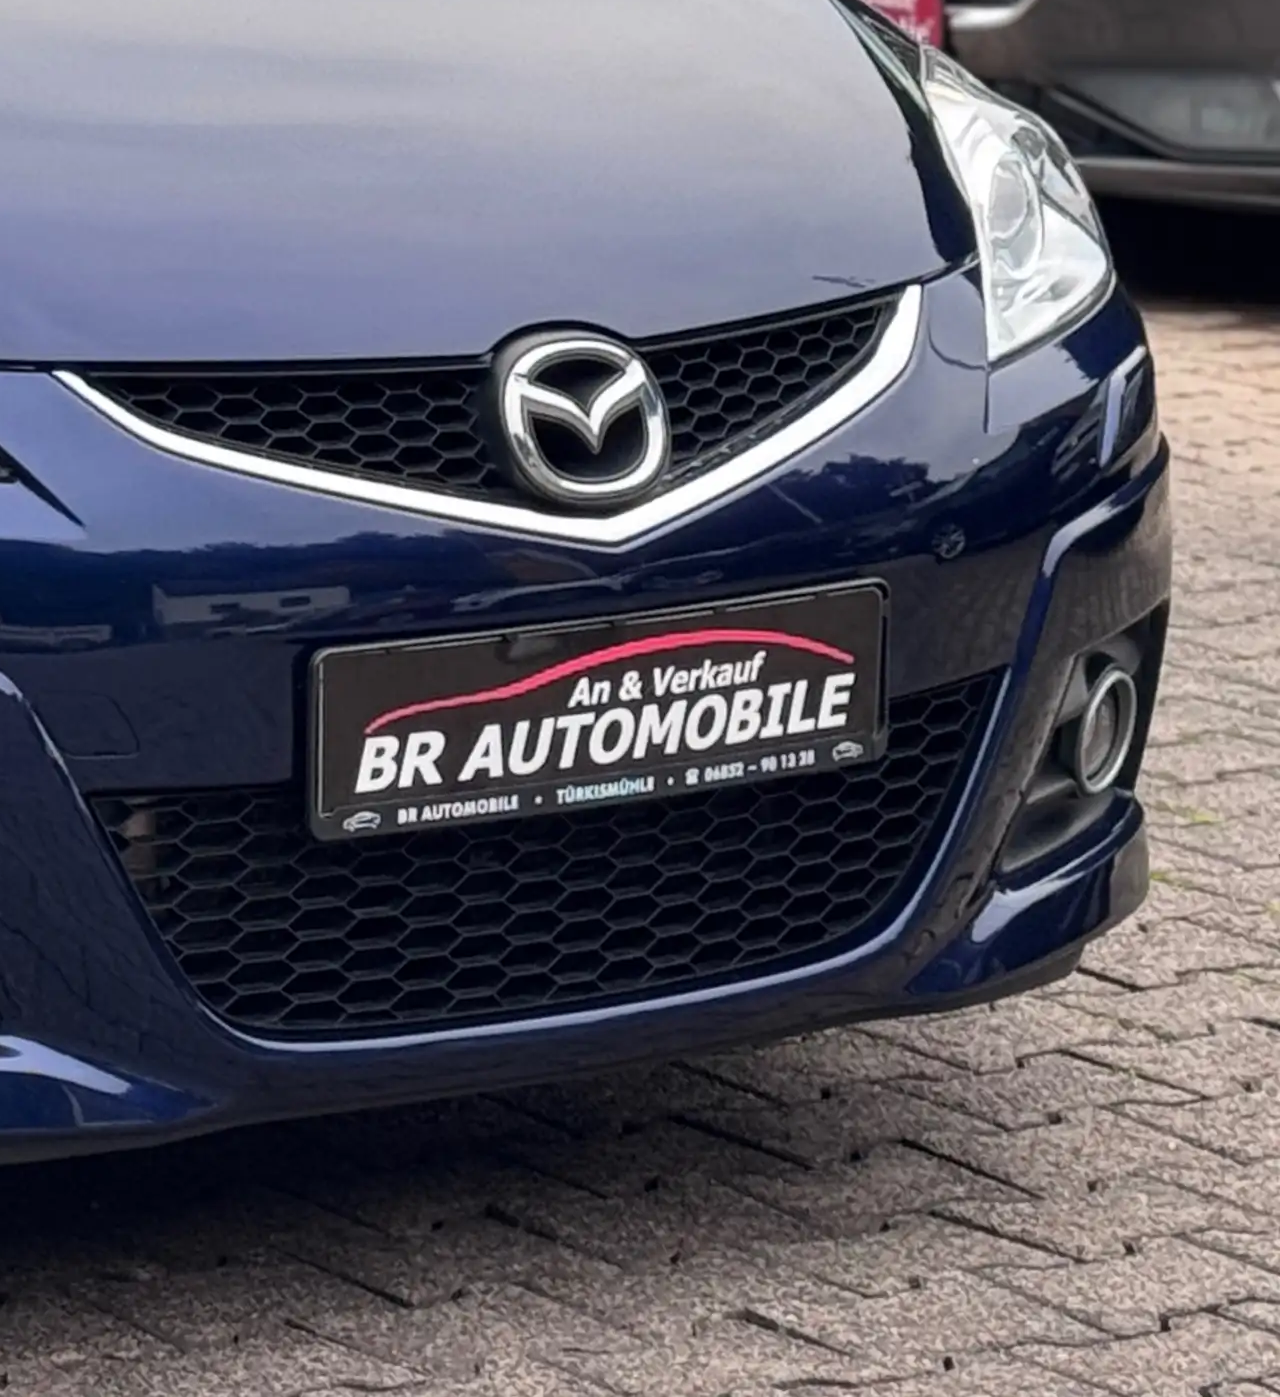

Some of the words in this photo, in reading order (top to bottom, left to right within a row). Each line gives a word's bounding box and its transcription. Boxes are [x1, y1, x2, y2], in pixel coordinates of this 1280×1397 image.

[567, 676, 611, 709] An
[618, 670, 643, 702] &
[653, 650, 767, 697] Verkauf
[354, 730, 446, 794] BR
[457, 672, 856, 782] AUTOMOBILE
[397, 807, 419, 825] BR
[420, 794, 520, 822] AUTOMOBILE
[556, 775, 655, 805] TÜRKISMÜHLE
